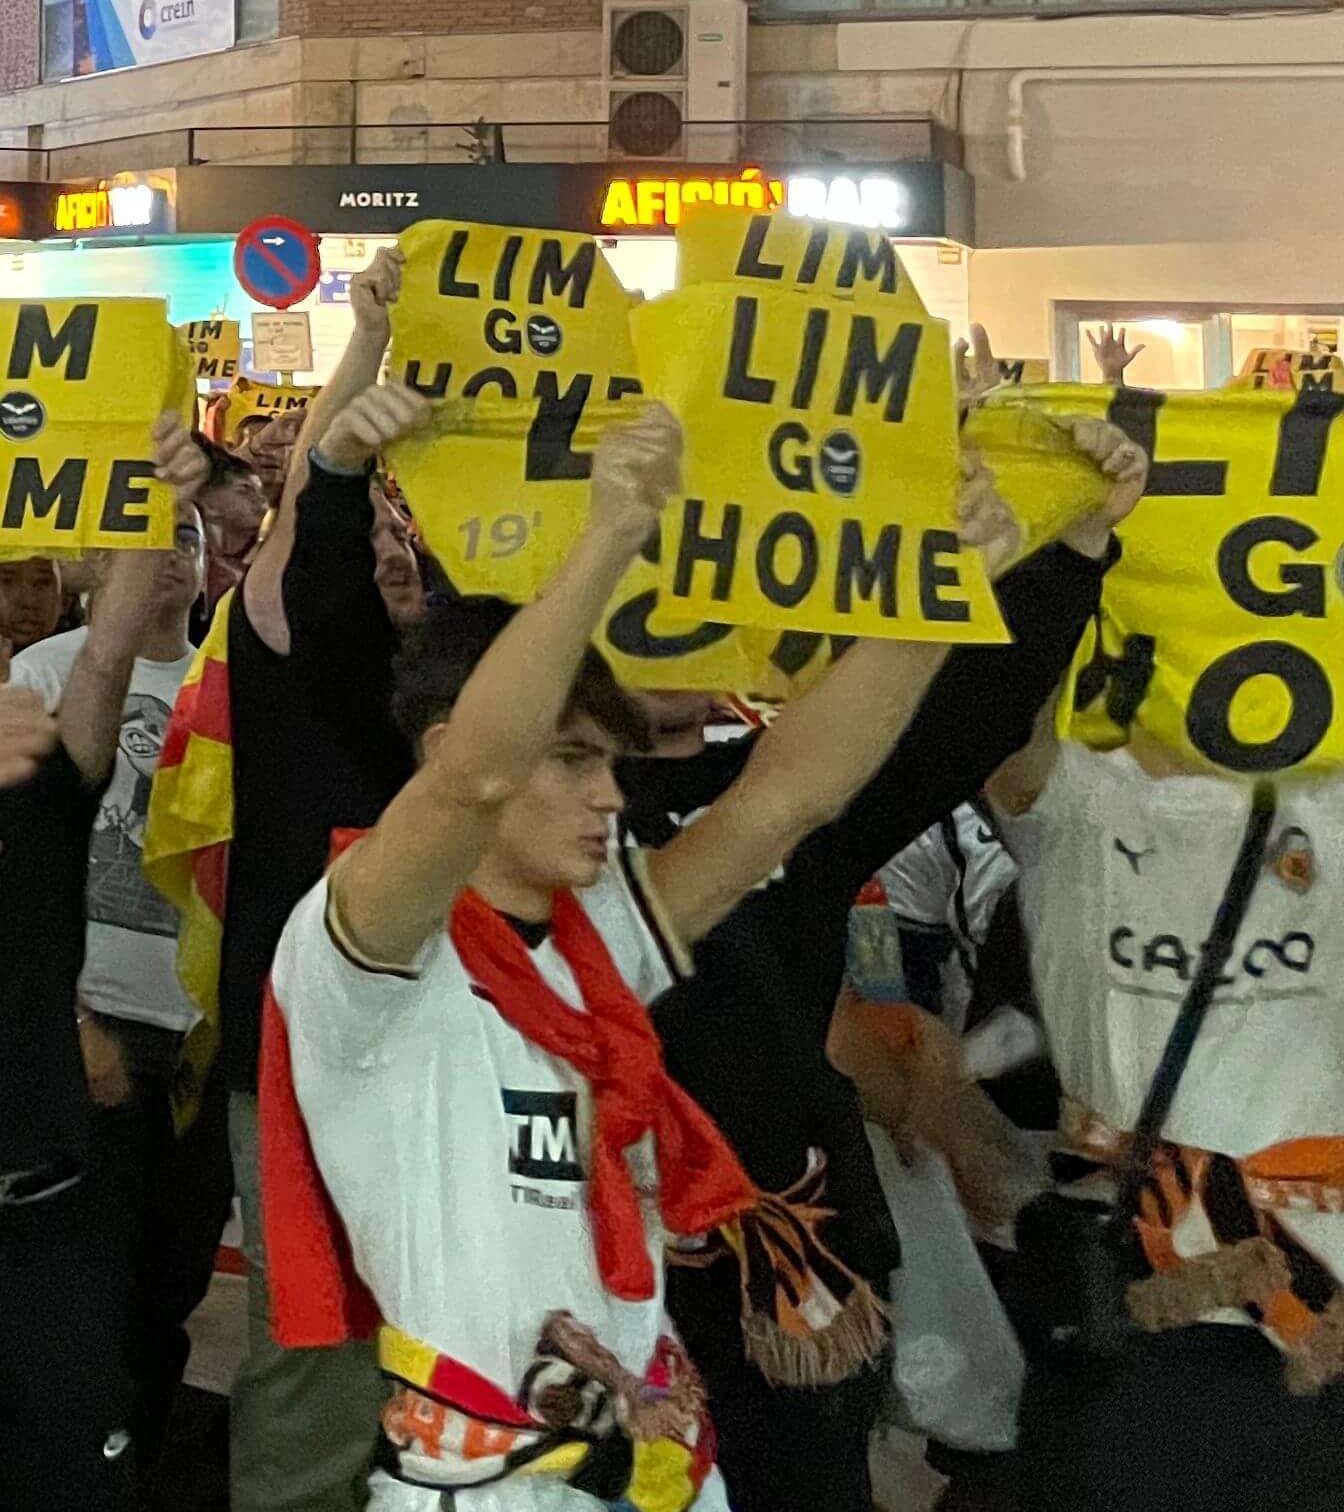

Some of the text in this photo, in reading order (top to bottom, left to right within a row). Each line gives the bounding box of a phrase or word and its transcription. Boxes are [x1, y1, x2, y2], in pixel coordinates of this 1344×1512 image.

[339, 191, 419, 208] MORITZ
[438, 230, 597, 309] LIM
[735, 214, 897, 294] LIM
[188, 321, 223, 339] IM
[197, 358, 237, 377] ME
[483, 308, 562, 357] GO
[723, 296, 923, 423] LIM
[256, 394, 309, 411] LIM
[768, 421, 861, 498] GO
[1106, 387, 1344, 498] LI
[672, 499, 972, 622] HOME
[1217, 514, 1344, 619] G
[505, 1112, 578, 1164] TM
